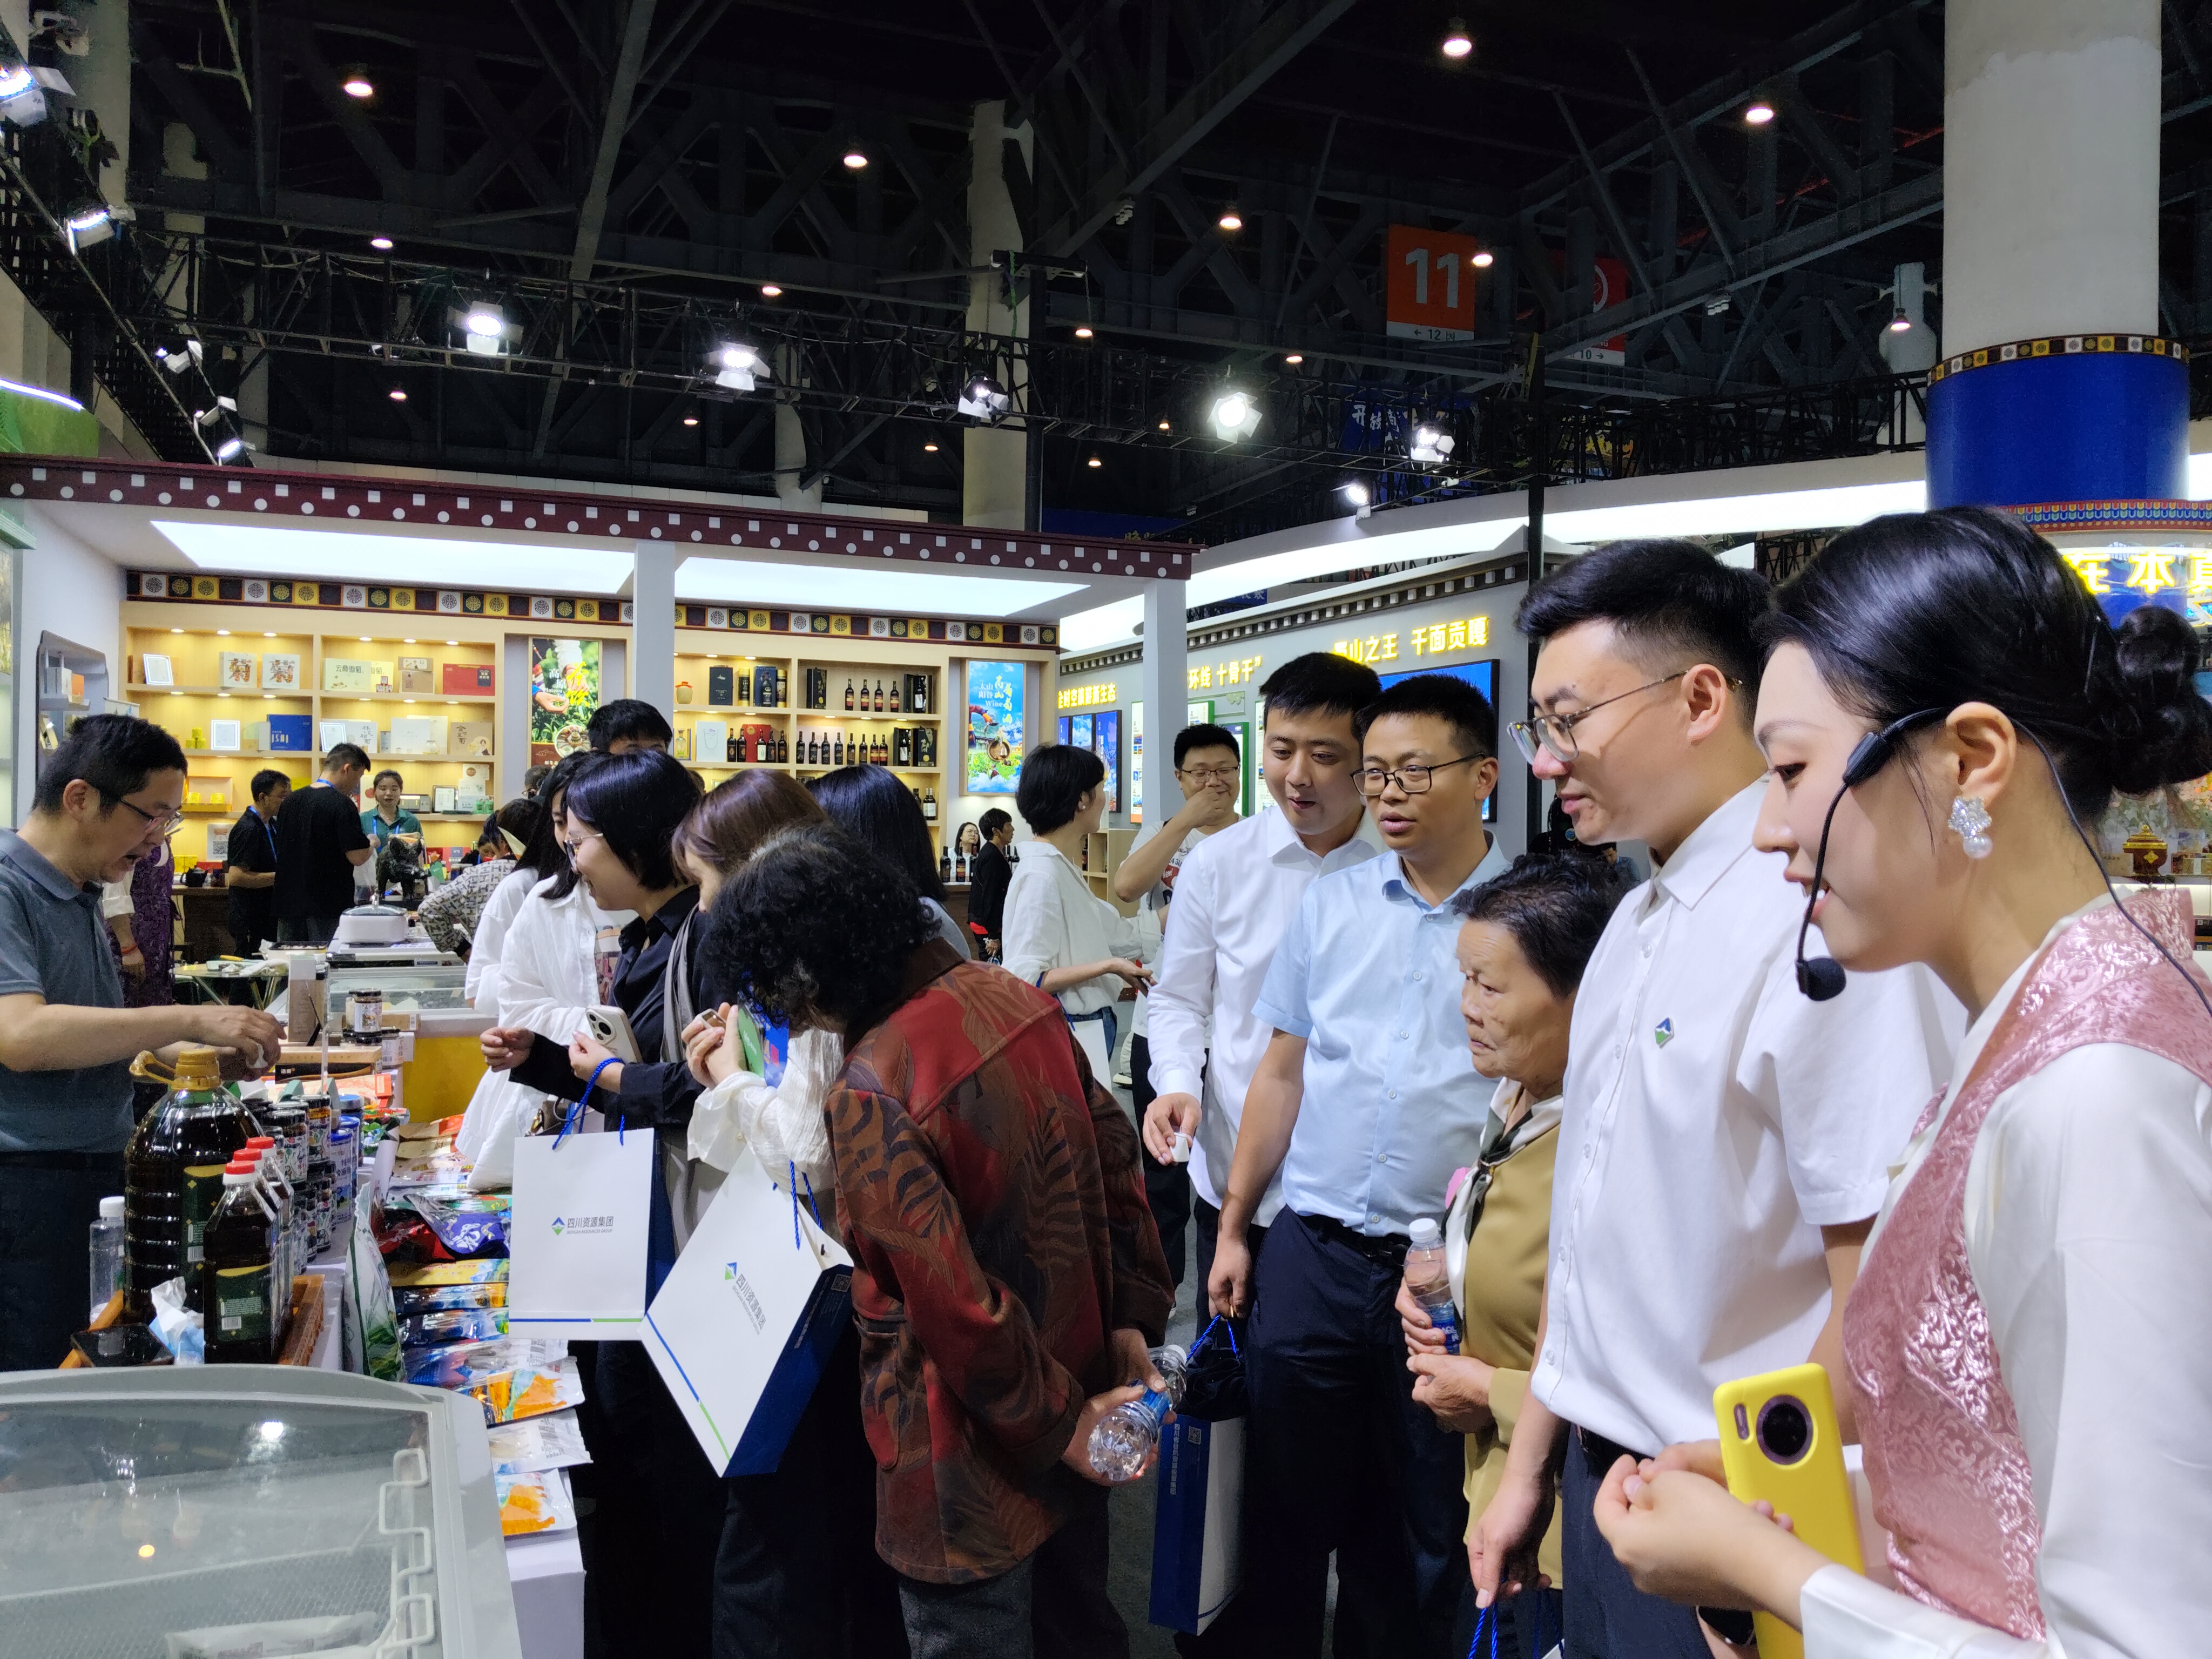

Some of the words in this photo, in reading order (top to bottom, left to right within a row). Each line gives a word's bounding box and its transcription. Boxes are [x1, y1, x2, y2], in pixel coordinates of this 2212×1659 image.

[1406, 248, 1459, 308] 11
[1427, 329, 1441, 340] 12
[1580, 349, 1592, 360] 10
[1411, 616, 1488, 656] 千面贡嘎
[1188, 665, 1212, 690] 环线
[1162, 867, 1174, 879] New!
[567, 1216, 614, 1229] 四川资源集团
[736, 1273, 766, 1331] 四川资源集团
